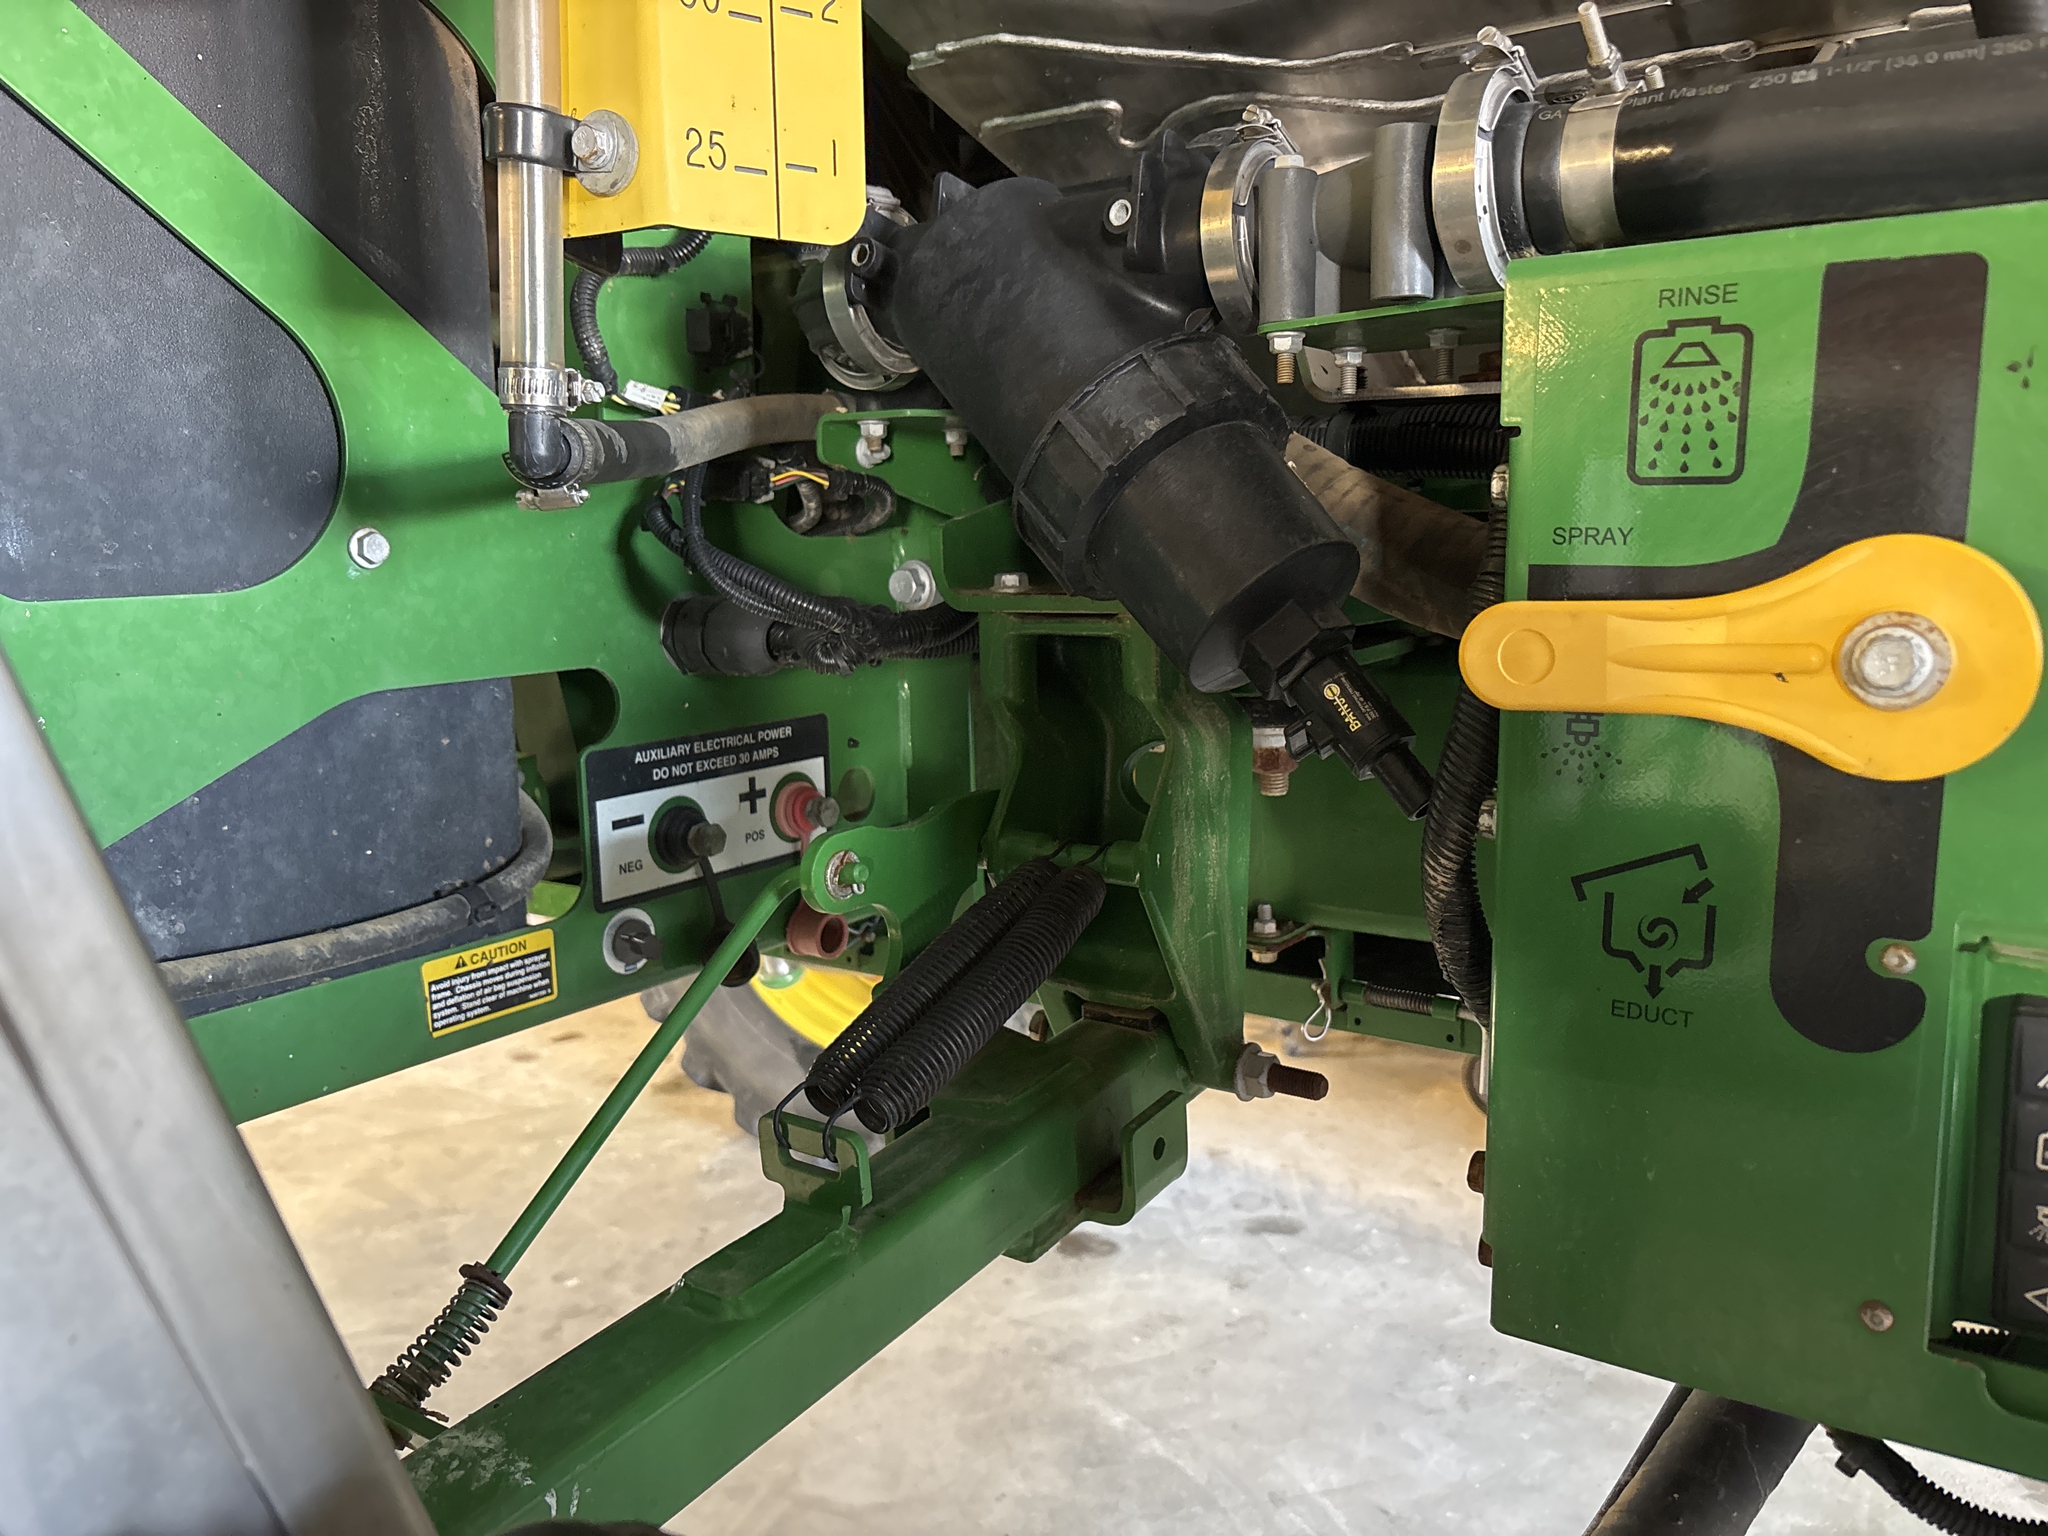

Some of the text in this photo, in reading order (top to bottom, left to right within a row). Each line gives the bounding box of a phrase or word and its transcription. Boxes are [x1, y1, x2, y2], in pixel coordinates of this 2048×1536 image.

[1669, 84, 1731, 100] Master
[686, 127, 727, 171] 25
[1658, 283, 1738, 308] RINSE
[1552, 526, 1634, 546] SPRAY
[1324, 683, 1362, 732] BANJO
[635, 726, 792, 764] AUXILIARY ELECTRICAL POWER
[652, 746, 779, 781] DO NOT EXCEED 30 AMPS
[745, 829, 765, 843] POS
[618, 859, 643, 875] NEG
[470, 940, 527, 965] CAUTION
[431, 953, 547, 992] Avoid injury from impact with sprayer
[455, 981, 482, 994] Chassis
[483, 974, 504, 986] moves
[504, 968, 525, 980] during
[526, 961, 550, 973] inflation
[432, 972, 542, 1011] and deflation of air bag suspension
[461, 998, 481, 1010] Stand
[482, 994, 498, 1004] clear
[498, 990, 506, 1000] of
[506, 984, 533, 997] machine
[533, 978, 550, 988] when
[433, 1013, 466, 1029] operating
[1611, 999, 1694, 1028] EDUCT
